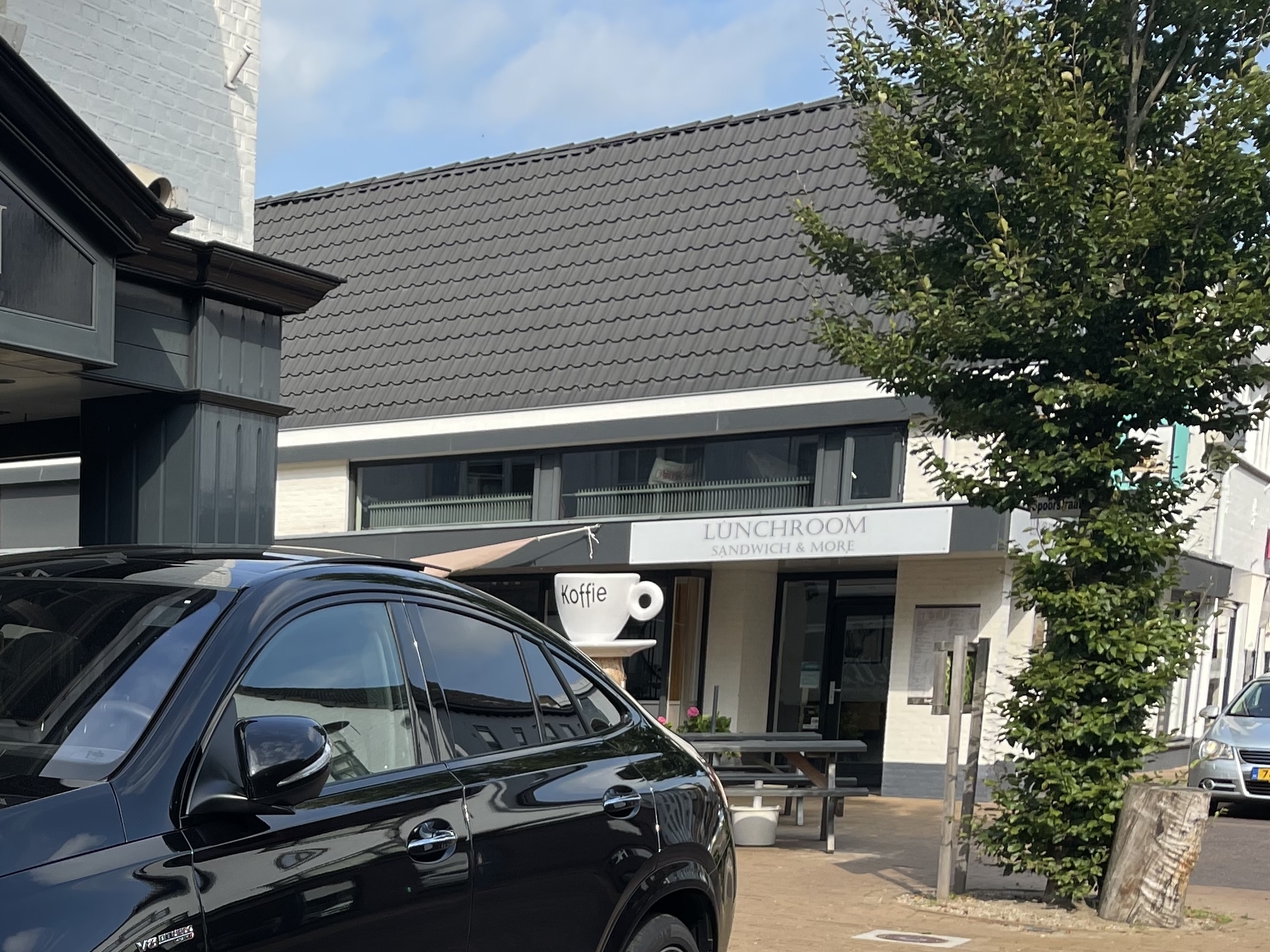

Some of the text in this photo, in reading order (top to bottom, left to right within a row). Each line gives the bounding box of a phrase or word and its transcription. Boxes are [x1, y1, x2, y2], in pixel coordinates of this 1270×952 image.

[703, 515, 867, 541] LUNCHROOM
[711, 539, 855, 557] SANDWICH & MORE
[561, 582, 607, 609] Koffie
[135, 936, 158, 952] V8
